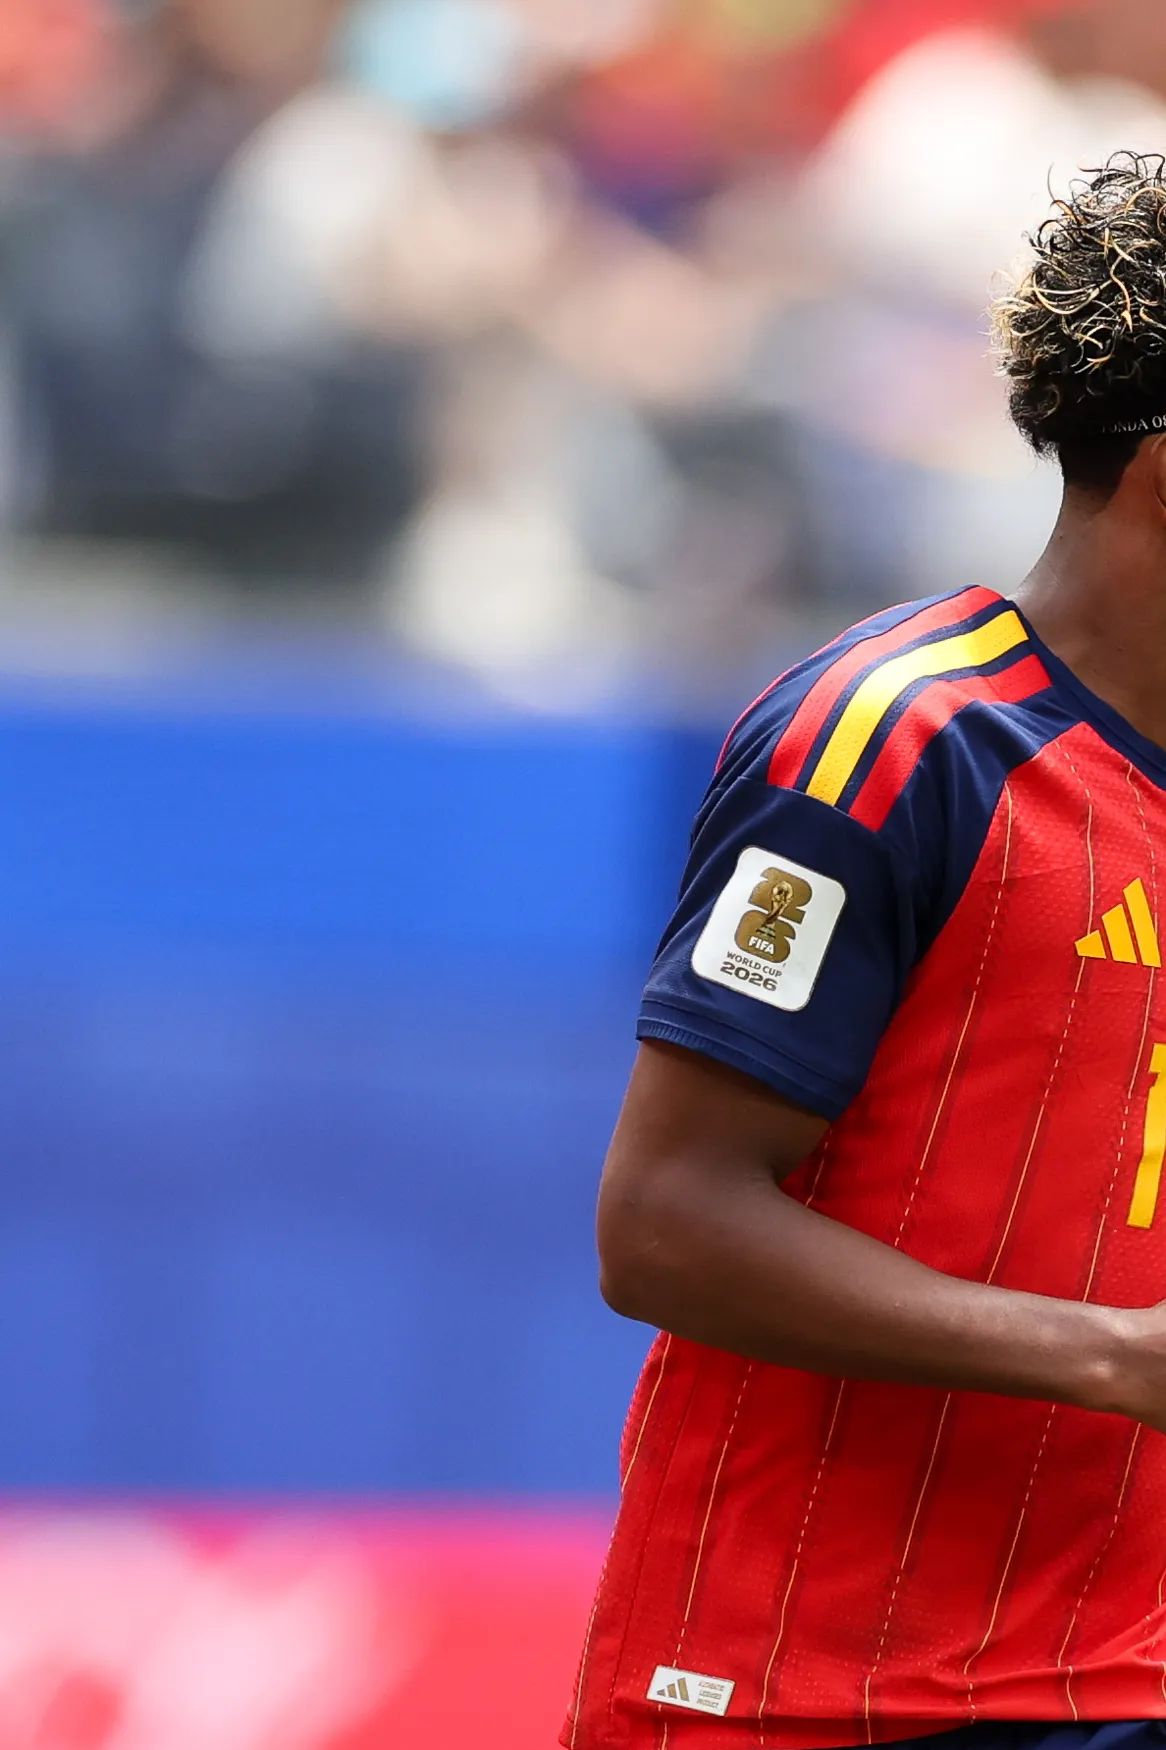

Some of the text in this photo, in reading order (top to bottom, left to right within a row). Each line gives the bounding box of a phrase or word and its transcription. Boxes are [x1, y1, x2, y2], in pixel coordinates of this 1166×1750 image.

[748, 935, 775, 955] FIFA
[719, 961, 778, 992] 2026
[726, 950, 783, 978] WORLD CUP
